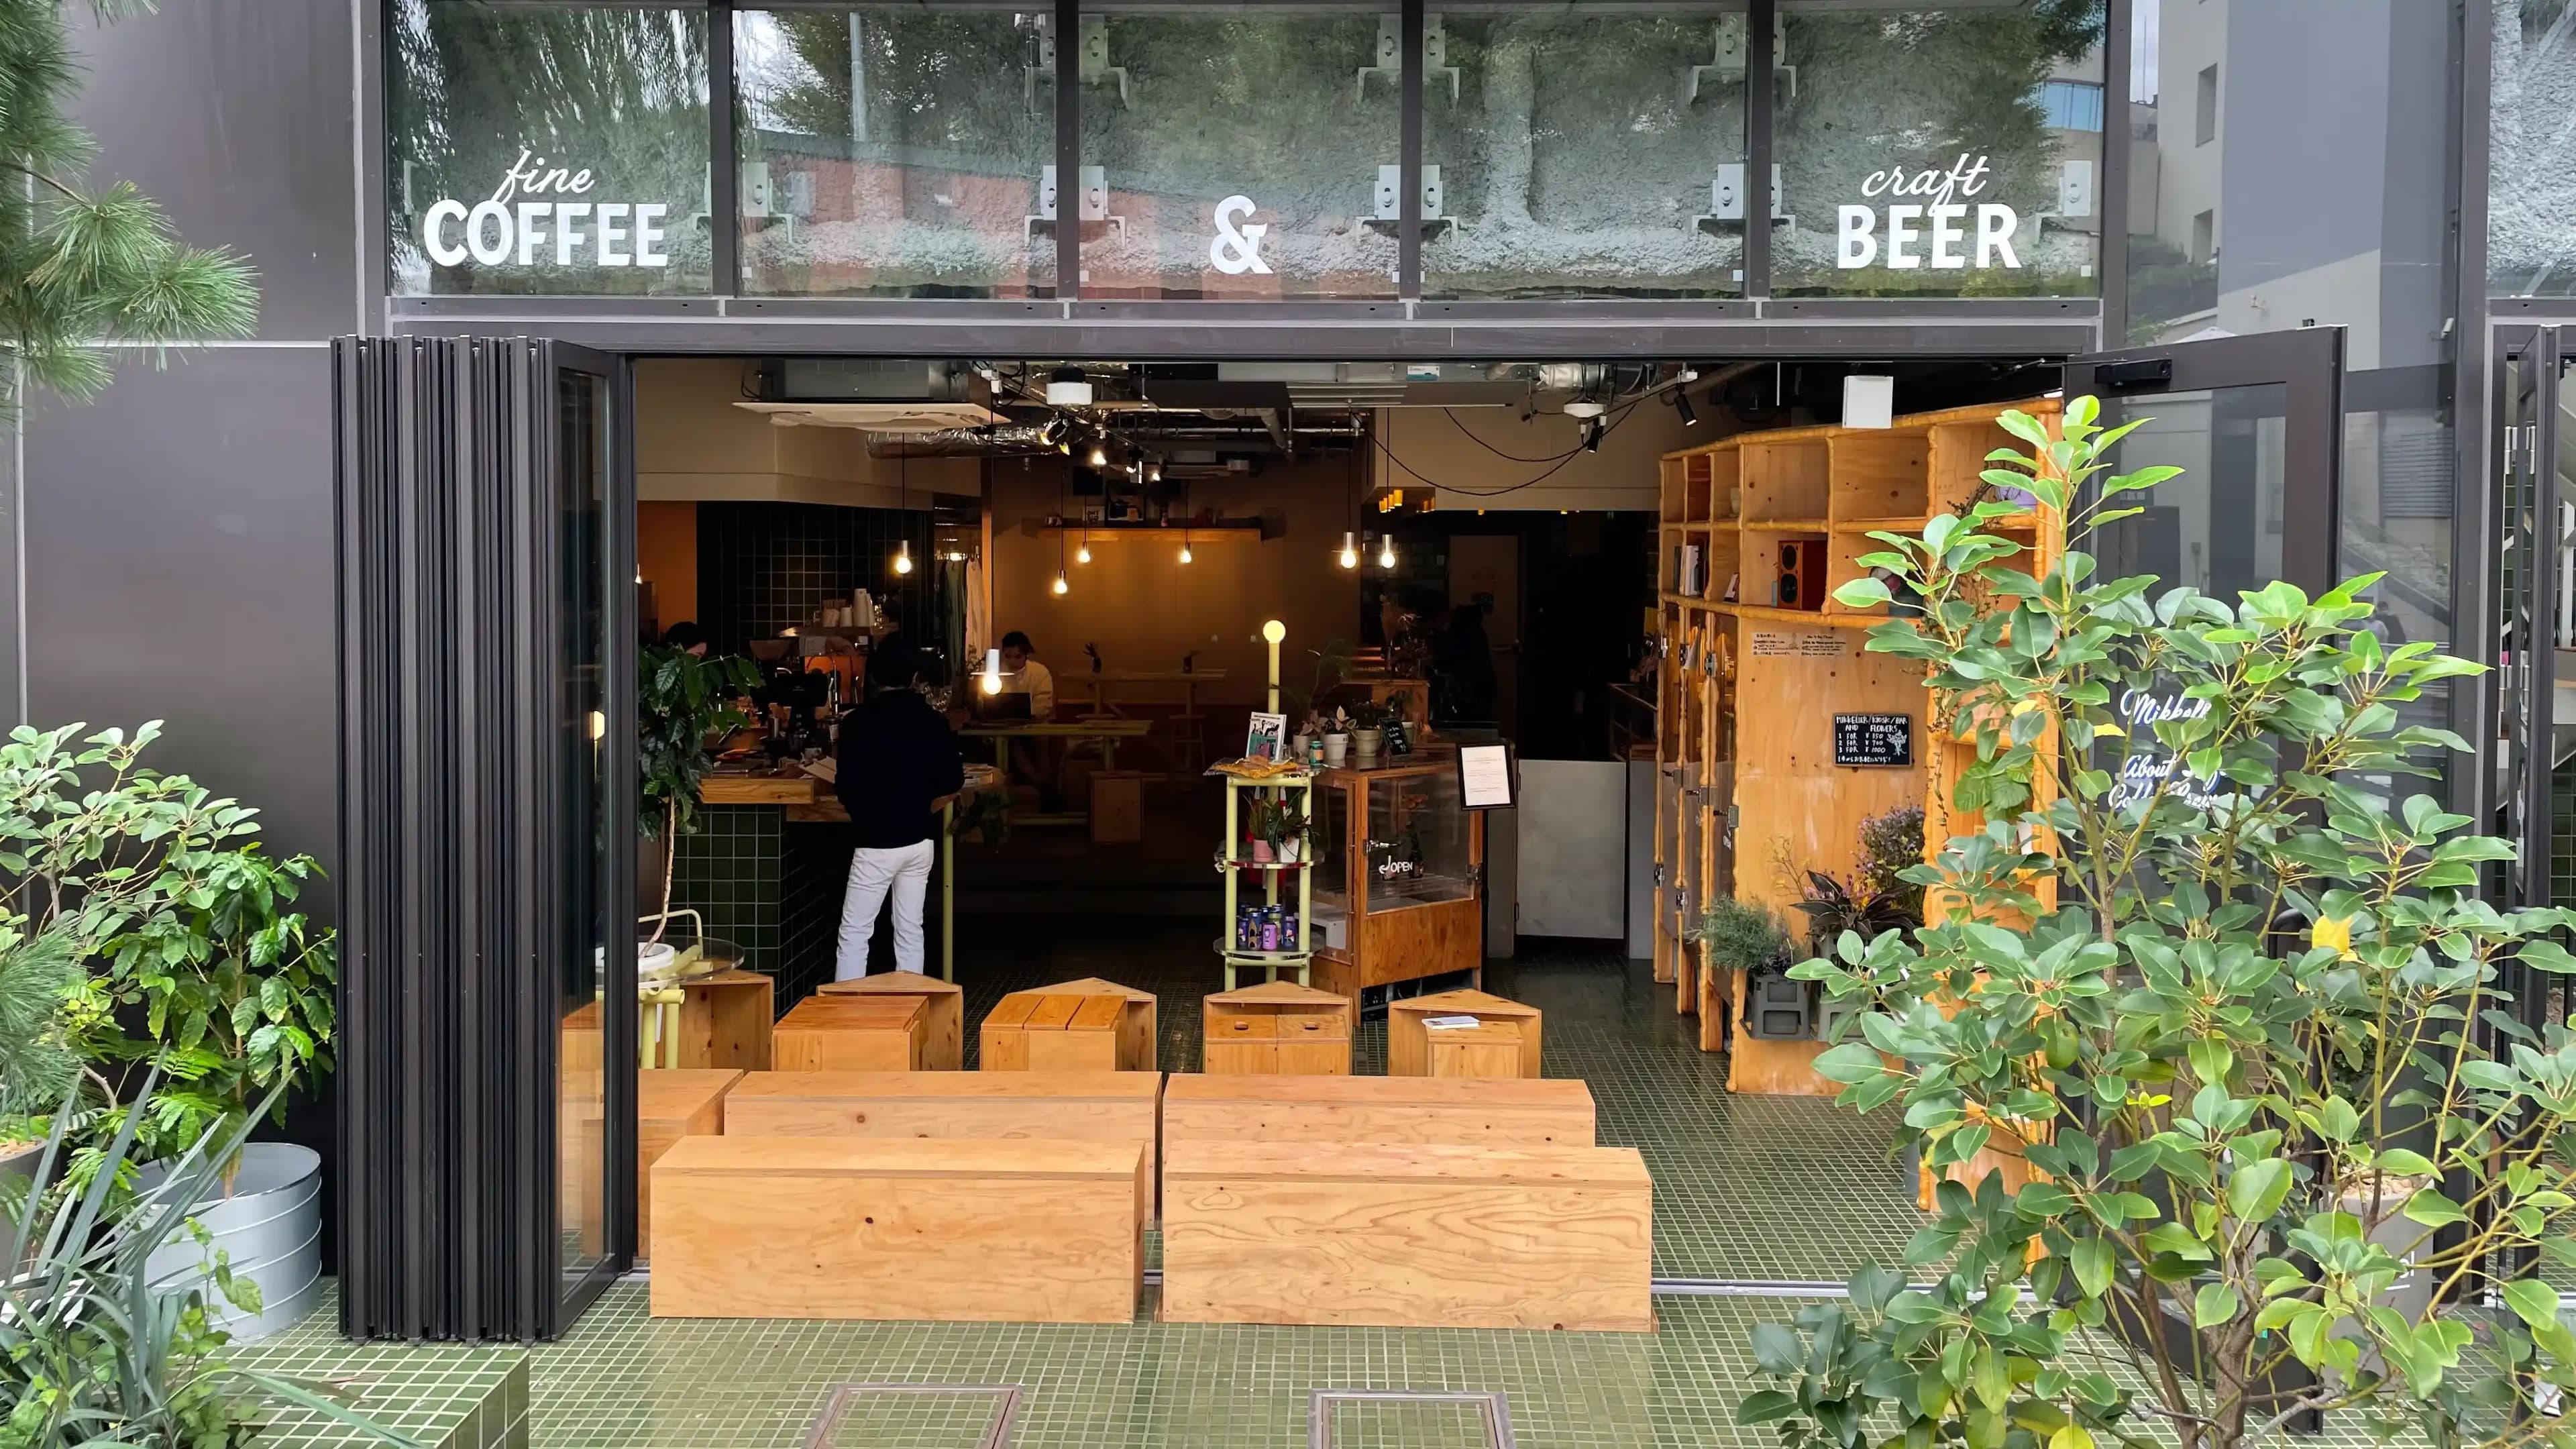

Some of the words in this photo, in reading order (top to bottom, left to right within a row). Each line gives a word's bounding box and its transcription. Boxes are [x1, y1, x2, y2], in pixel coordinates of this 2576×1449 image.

[492, 150, 595, 204] fine
[1861, 153, 1990, 217] craft
[423, 199, 668, 266] COFFEE
[1210, 195, 1274, 274] &
[1837, 203, 2023, 269] BEER
[1870, 724, 1898, 733] FLOWERS
[2123, 754, 2174, 779] About
[1390, 861, 1413, 873] OPEN
